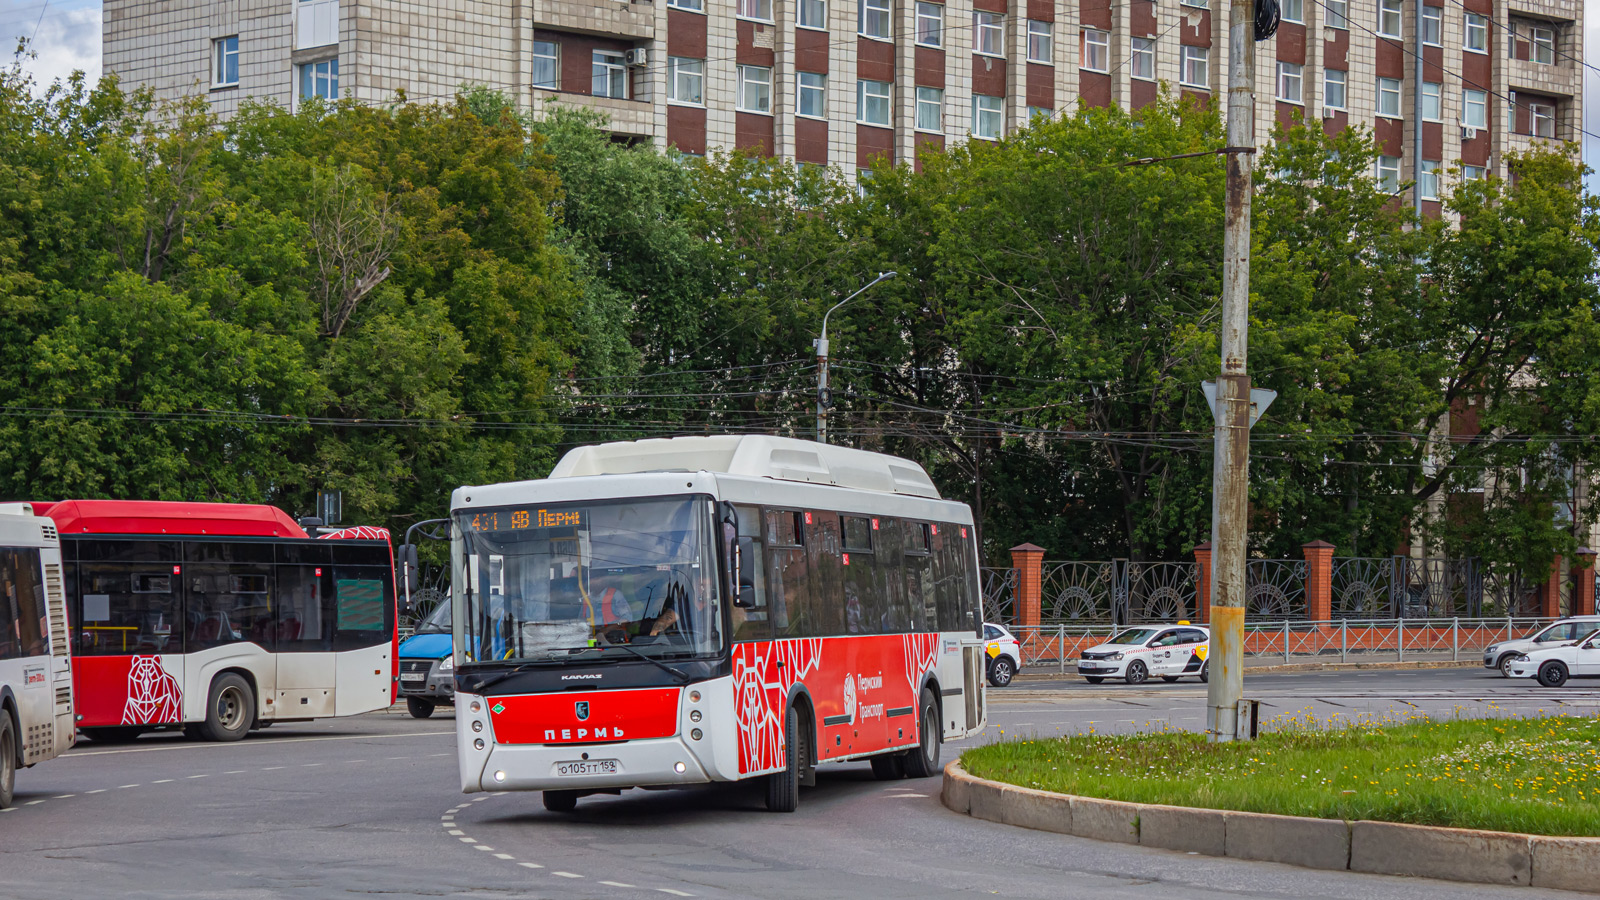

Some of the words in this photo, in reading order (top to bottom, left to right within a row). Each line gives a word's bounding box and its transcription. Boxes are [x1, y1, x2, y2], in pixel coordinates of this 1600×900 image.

[511, 510, 530, 529] АВ
[857, 670, 883, 695] Пермский
[858, 701, 884, 724] Транспорт
[544, 727, 625, 740] ПЕРМЬ
